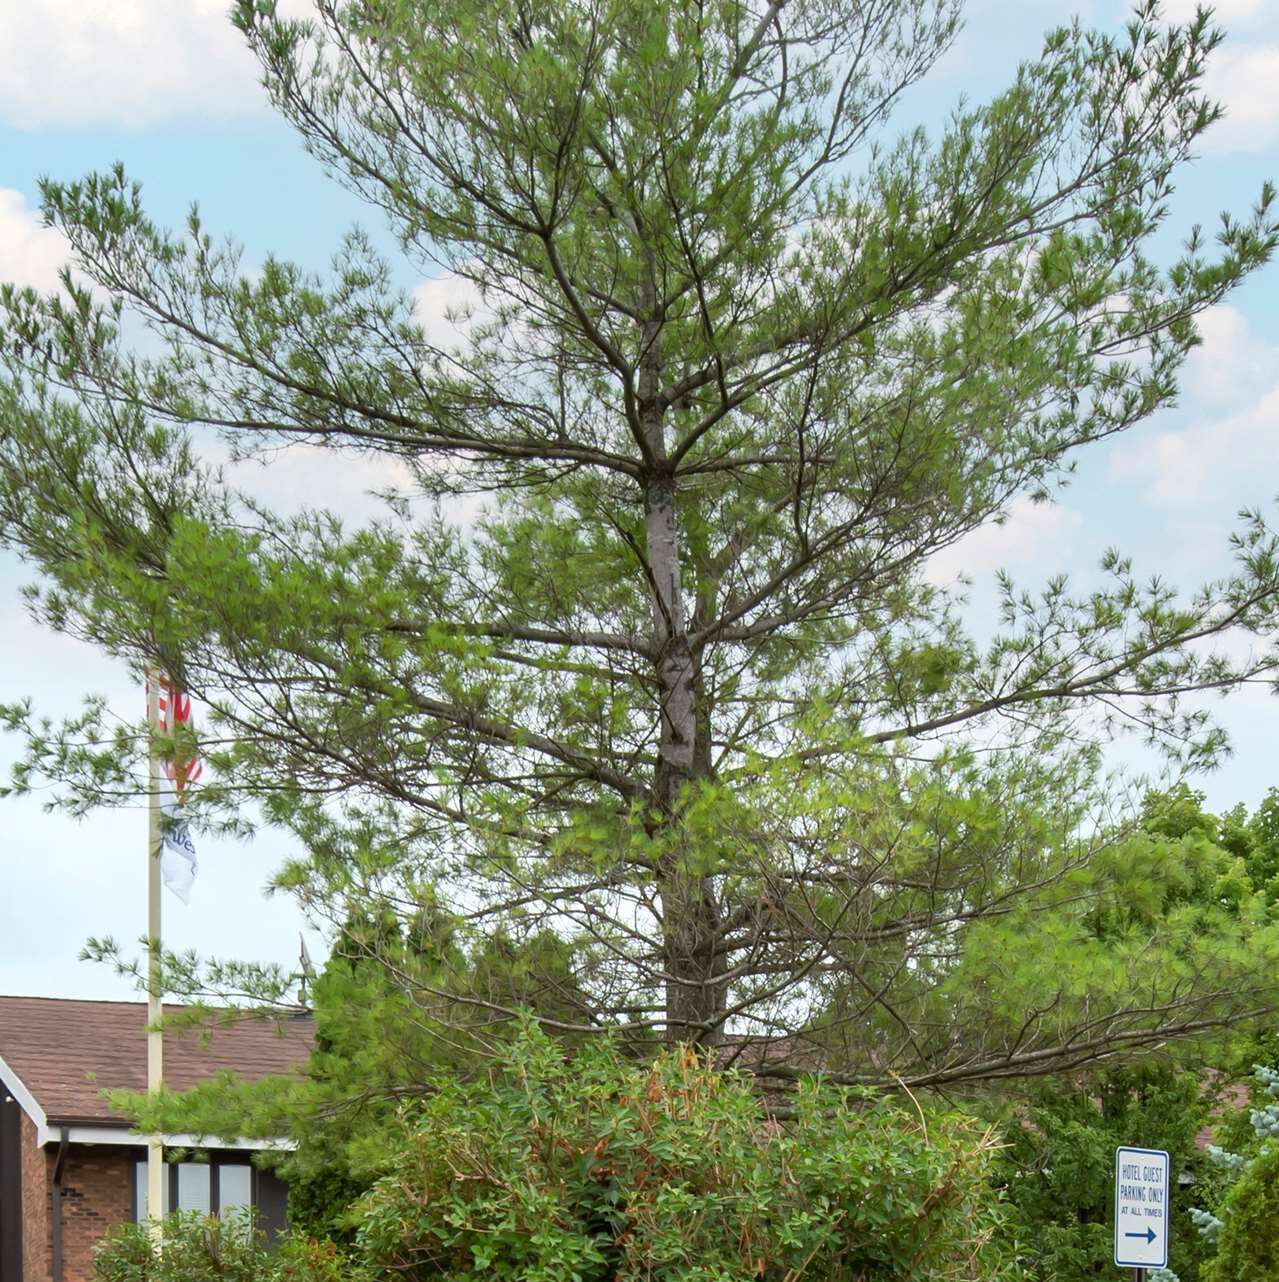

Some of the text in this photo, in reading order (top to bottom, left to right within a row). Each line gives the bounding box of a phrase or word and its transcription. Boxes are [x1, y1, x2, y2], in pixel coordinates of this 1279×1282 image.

[1122, 1164, 1162, 1183] HOTEL GUEST
[1120, 1185, 1163, 1203] PARKING ONLY
[1121, 1206, 1162, 1218] AT ALL TIMES
